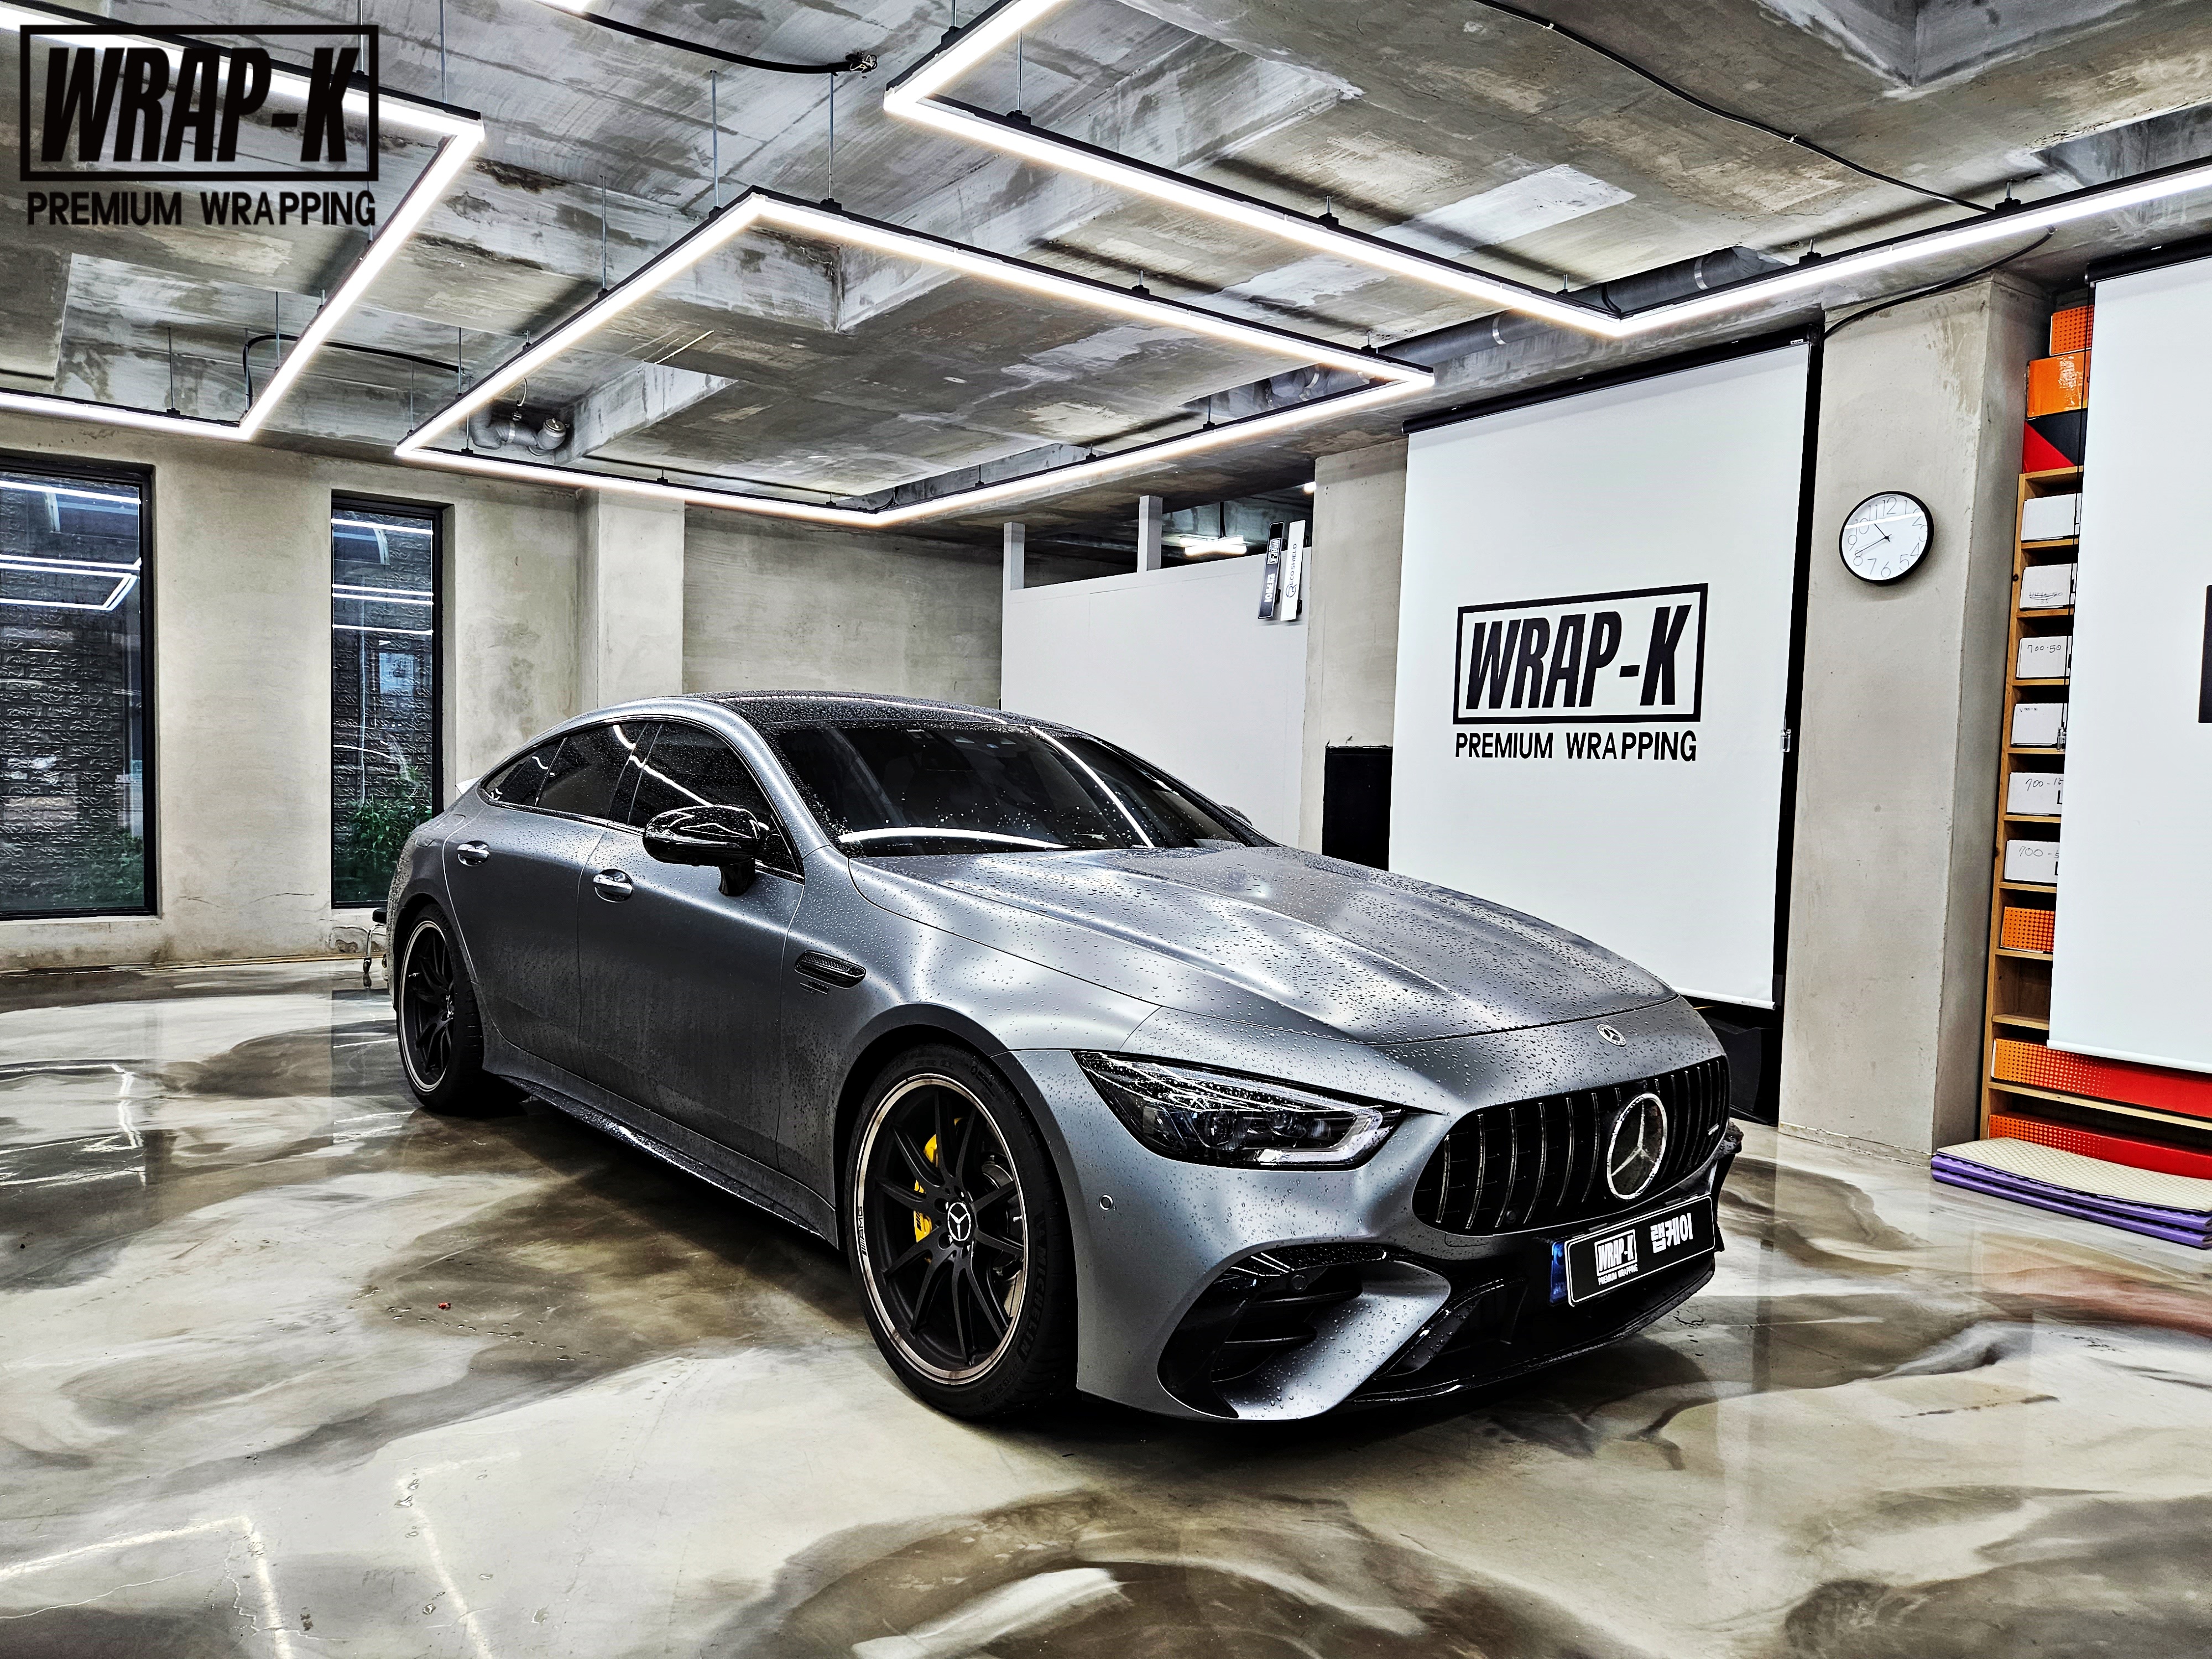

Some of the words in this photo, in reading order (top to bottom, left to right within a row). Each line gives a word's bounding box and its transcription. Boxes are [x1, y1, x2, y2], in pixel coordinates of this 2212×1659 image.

[1882, 497, 1896, 517] 12
[1848, 534, 1858, 551] 9
[1910, 542, 1920, 557] 4
[1867, 558, 1877, 575] 7
[1881, 561, 1891, 578] 6
[1899, 554, 1909, 571] 5
[1465, 604, 1692, 709] WRAP-K
[1455, 732, 1553, 759] PREMIUM
[1566, 730, 1697, 762] WRAPPING
[1650, 1213, 1693, 1253] 랩케이
[1598, 1234, 1634, 1271] WRAP-K
[1019, 1245, 1047, 1357] MICHELIN
